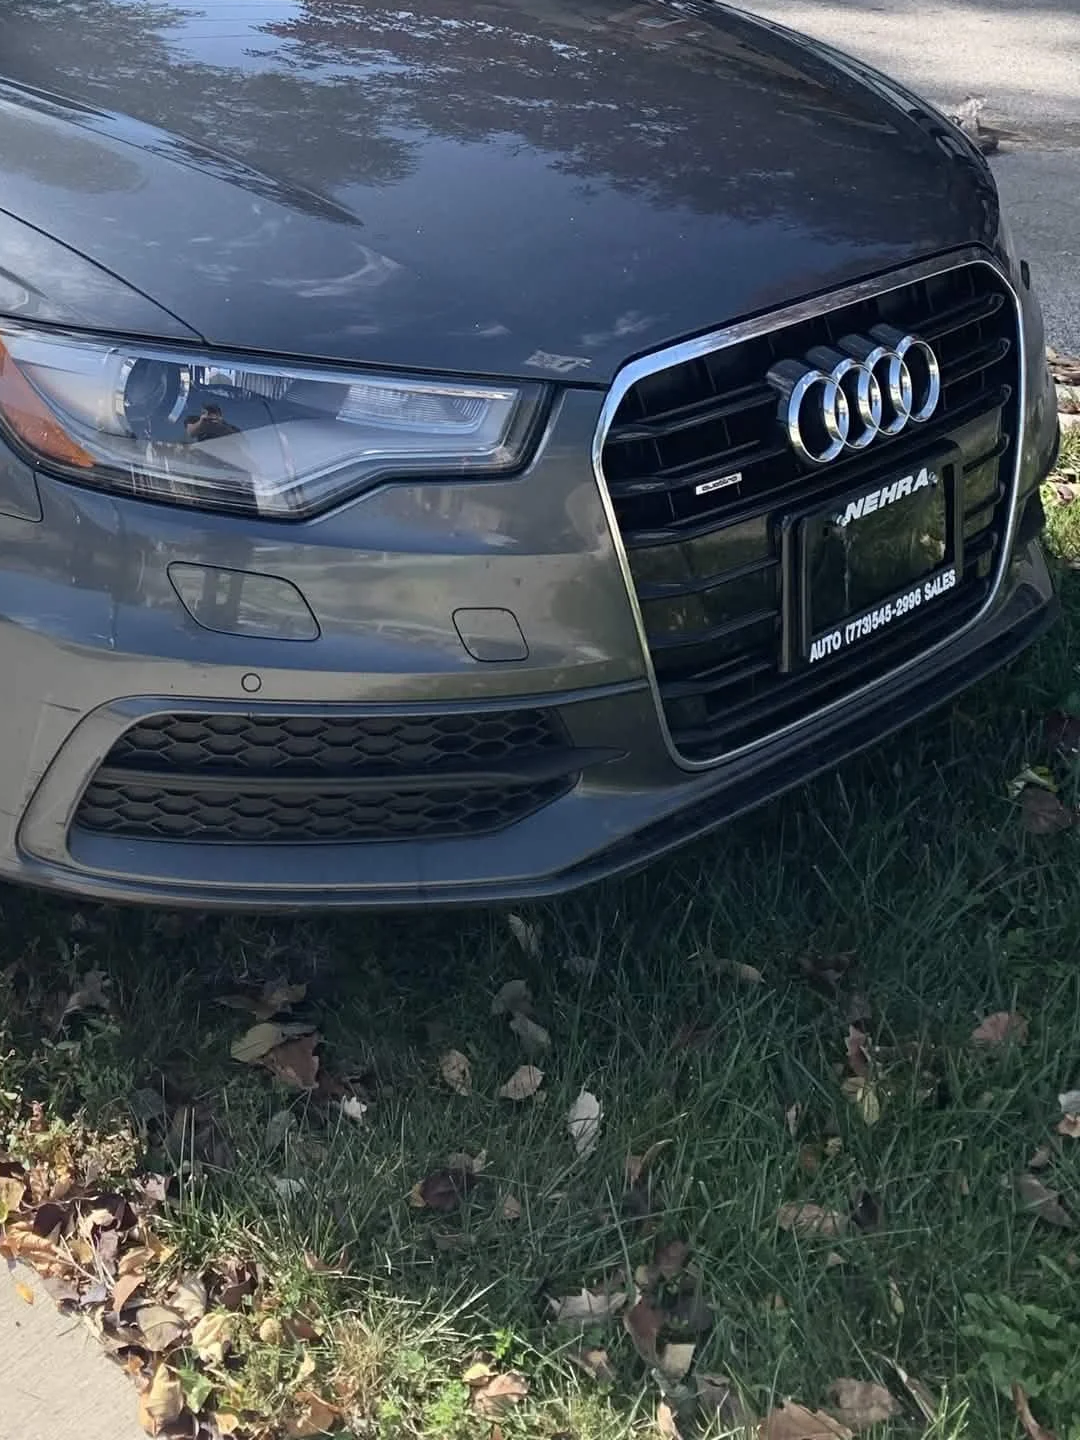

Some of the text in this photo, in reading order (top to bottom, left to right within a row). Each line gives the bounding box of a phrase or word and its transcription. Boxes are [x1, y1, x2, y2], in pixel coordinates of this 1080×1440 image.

[843, 467, 929, 523] NEHRA
[809, 631, 842, 663] AUTO
[924, 569, 956, 601] SALES
